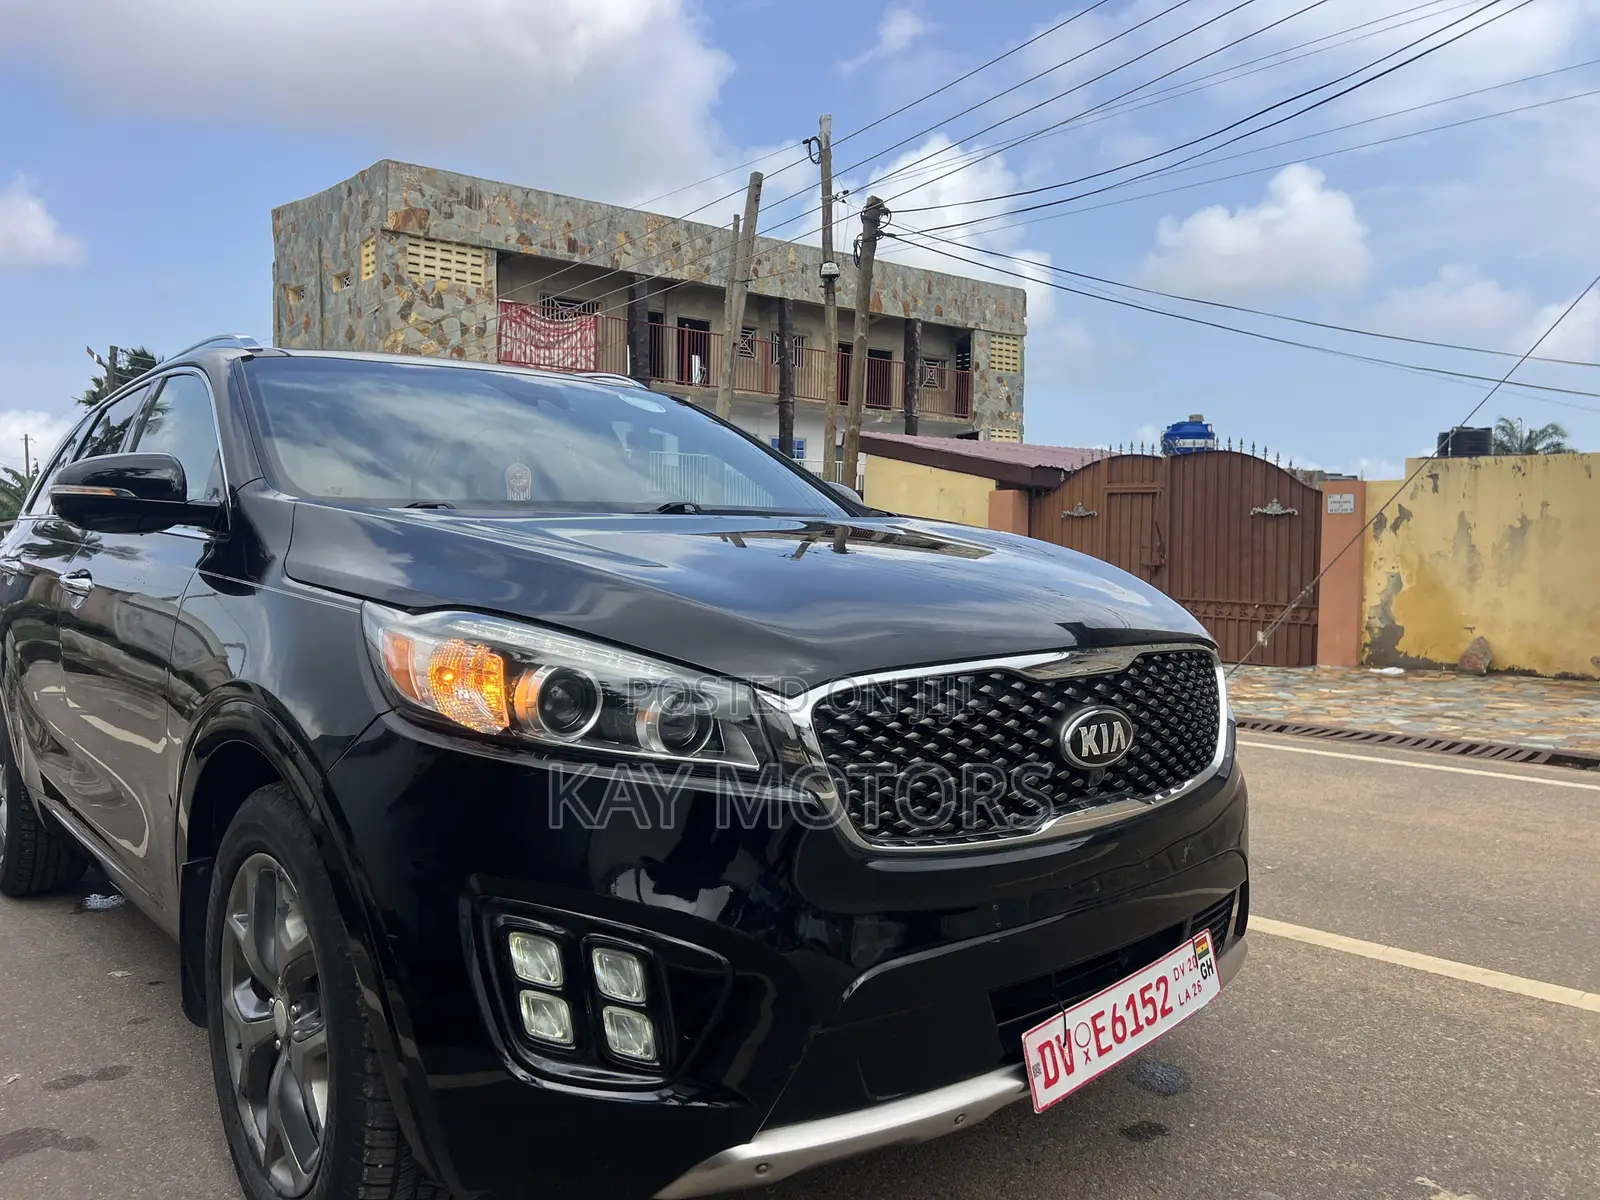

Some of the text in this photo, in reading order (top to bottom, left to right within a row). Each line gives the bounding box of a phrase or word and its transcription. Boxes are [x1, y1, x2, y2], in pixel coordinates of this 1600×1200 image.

[1079, 721, 1126, 757] KIA
[1173, 963, 1185, 982] DV
[1200, 957, 1214, 980] GH
[1178, 980, 1203, 1006] LA 26
[1037, 1028, 1075, 1090] DV
[1090, 975, 1174, 1058] E6152
